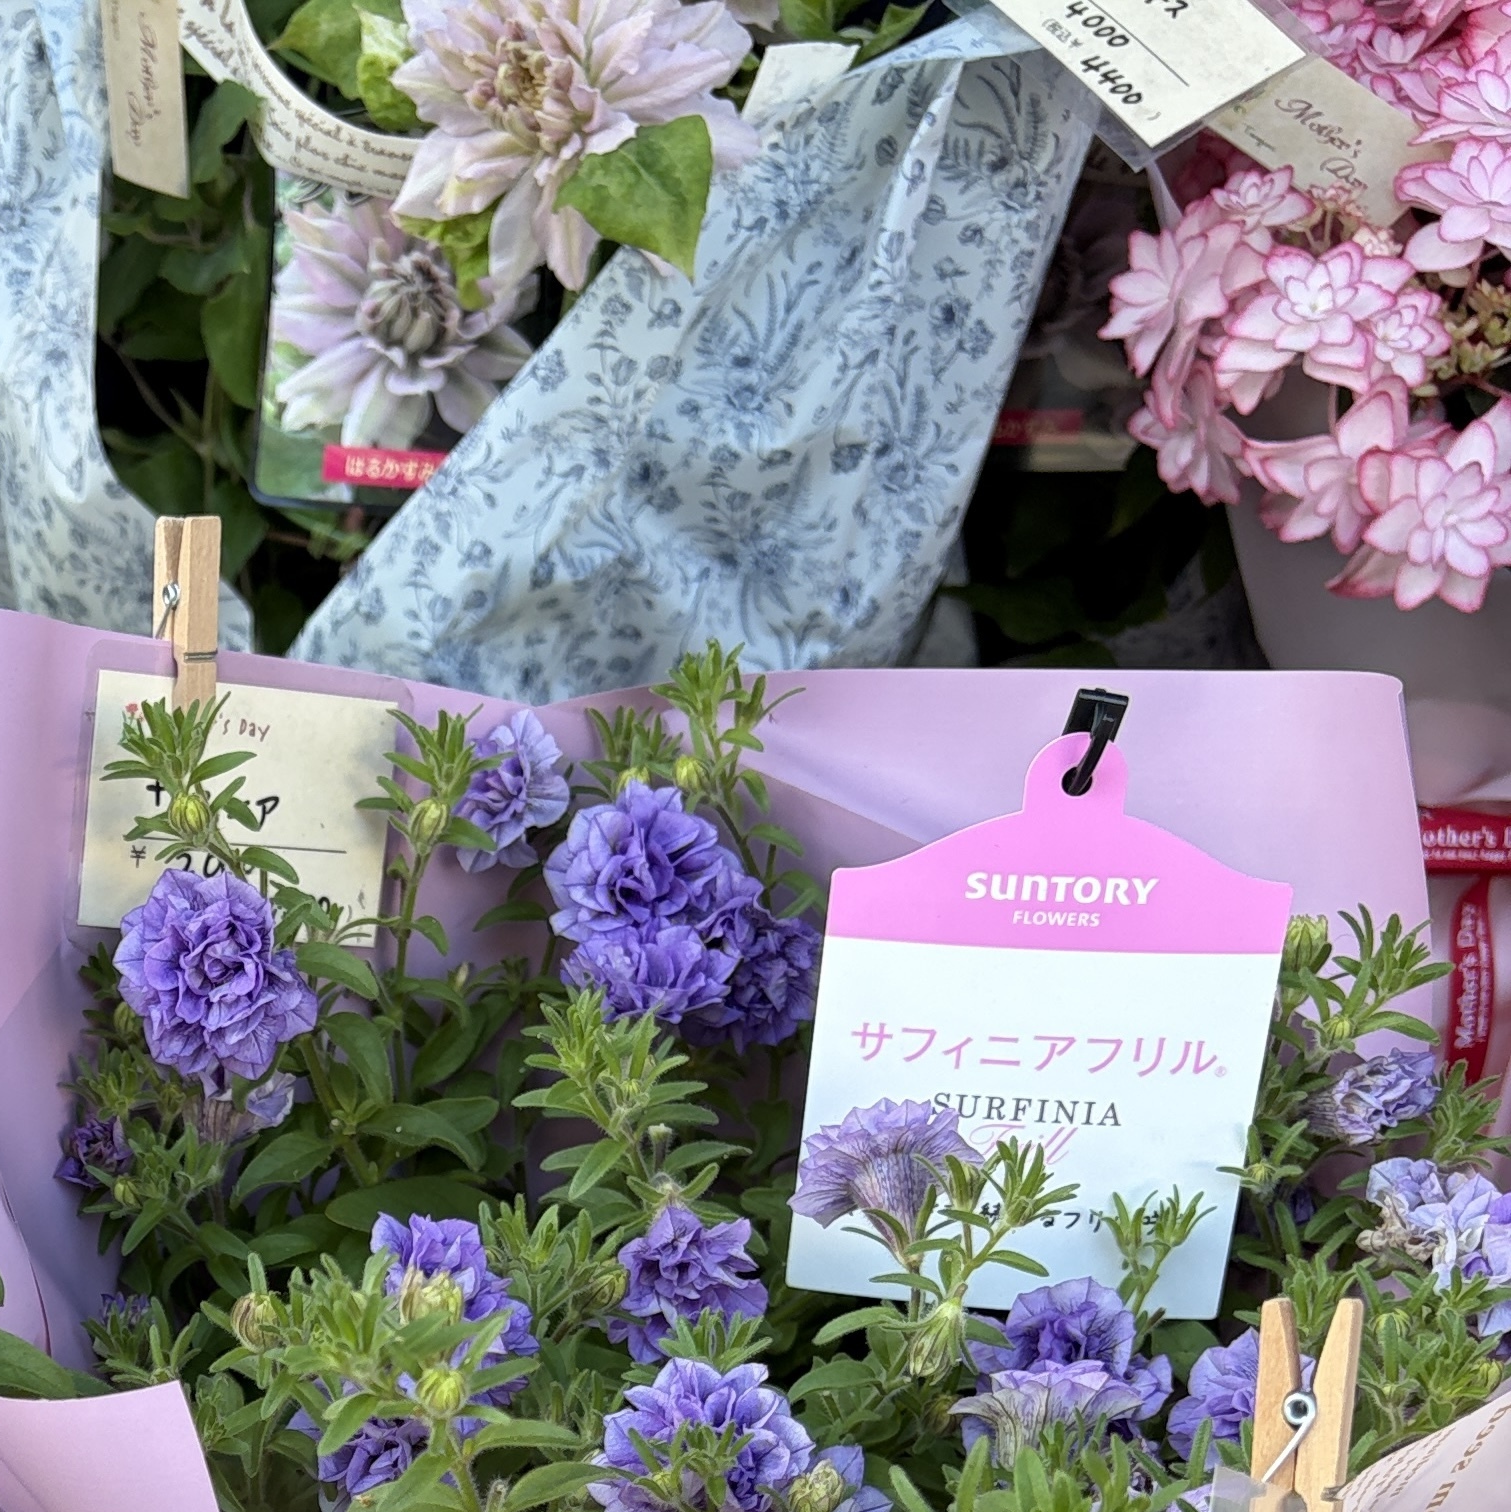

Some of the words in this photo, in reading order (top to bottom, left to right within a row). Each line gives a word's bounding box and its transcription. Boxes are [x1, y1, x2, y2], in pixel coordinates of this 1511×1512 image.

[1066, 1, 1129, 47] 4000
[1080, 56, 1143, 104] 4400
[345, 455, 435, 482] はるかすみ
[1423, 826, 1497, 848] other's
[965, 871, 1159, 906] SUNTORY
[1012, 910, 1101, 928] FLOWERS
[932, 1092, 1122, 1127] SURFINIA
